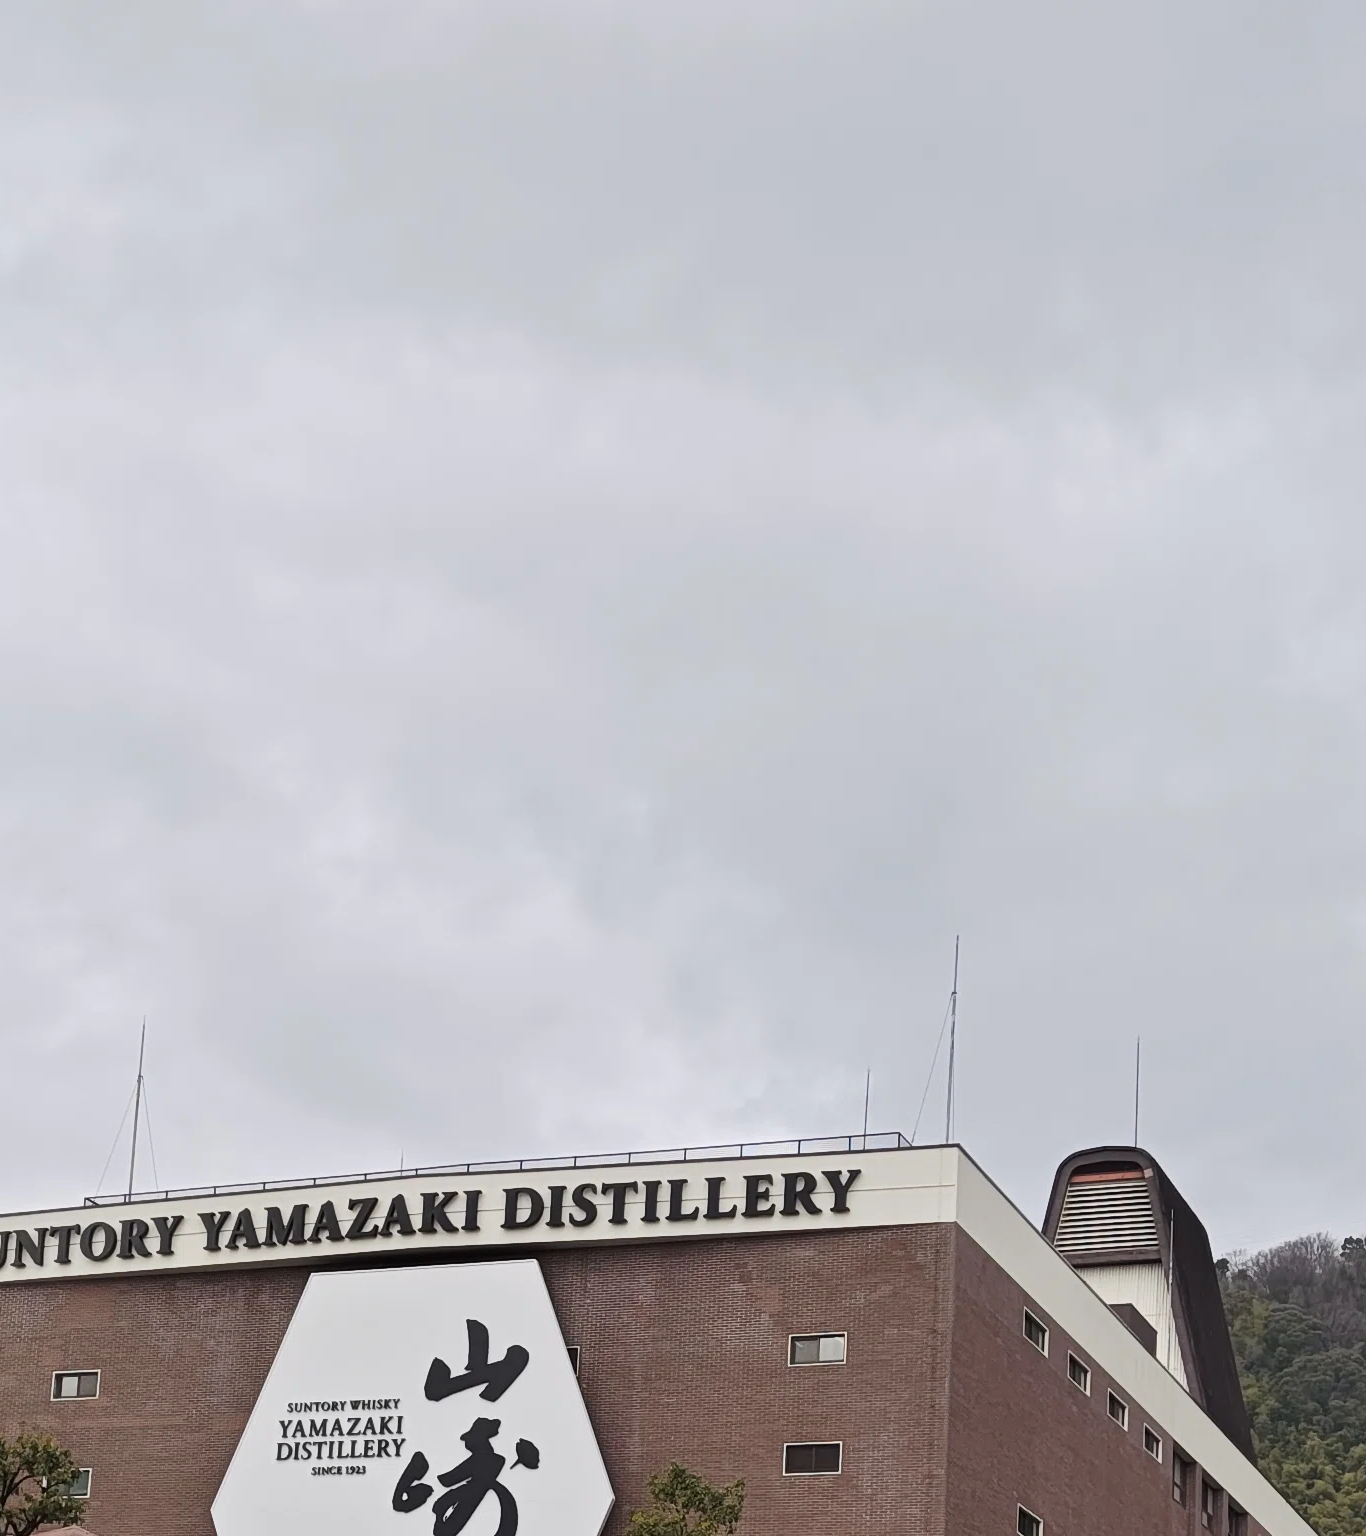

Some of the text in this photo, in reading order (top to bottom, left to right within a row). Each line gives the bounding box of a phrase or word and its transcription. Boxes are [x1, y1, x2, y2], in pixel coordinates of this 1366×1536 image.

[197, 1189, 482, 1252] YAMAZAKI
[500, 1168, 862, 1229] DISTILLERY
[286, 1398, 401, 1413] SUNTORY WHISKY
[278, 1415, 404, 1439] YAMAZAKI
[276, 1438, 407, 1461] DISTILLERY
[311, 1464, 367, 1476] SINCE 1923
